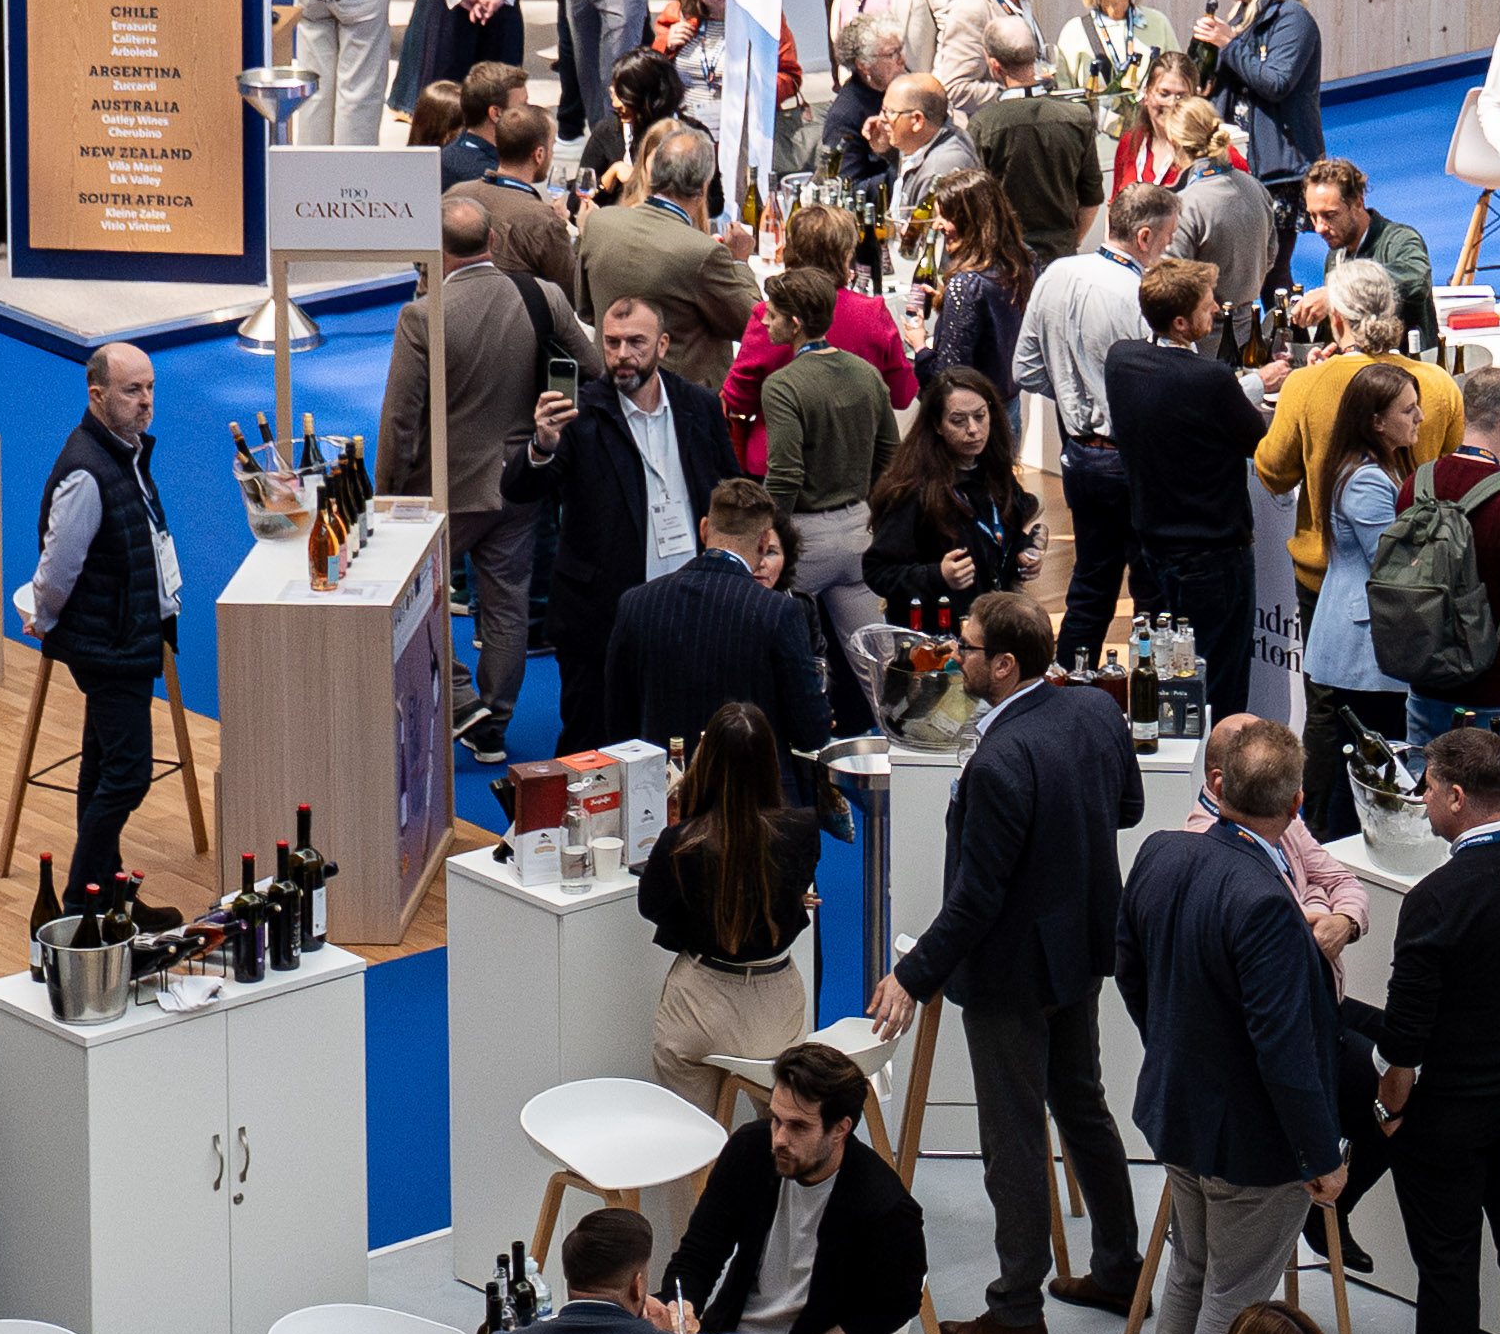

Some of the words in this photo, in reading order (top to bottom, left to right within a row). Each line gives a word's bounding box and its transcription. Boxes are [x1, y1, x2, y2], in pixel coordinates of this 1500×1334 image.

[110, 6, 160, 19] CHILE
[88, 65, 182, 79] ARGENTINA
[90, 99, 180, 113] AUSTRALIA
[79, 145, 116, 158] NEW
[119, 147, 193, 161] ZEALAND
[78, 192, 132, 206] SOUTH
[135, 193, 194, 208] AFRICA
[295, 199, 414, 218] CARIÑENA
